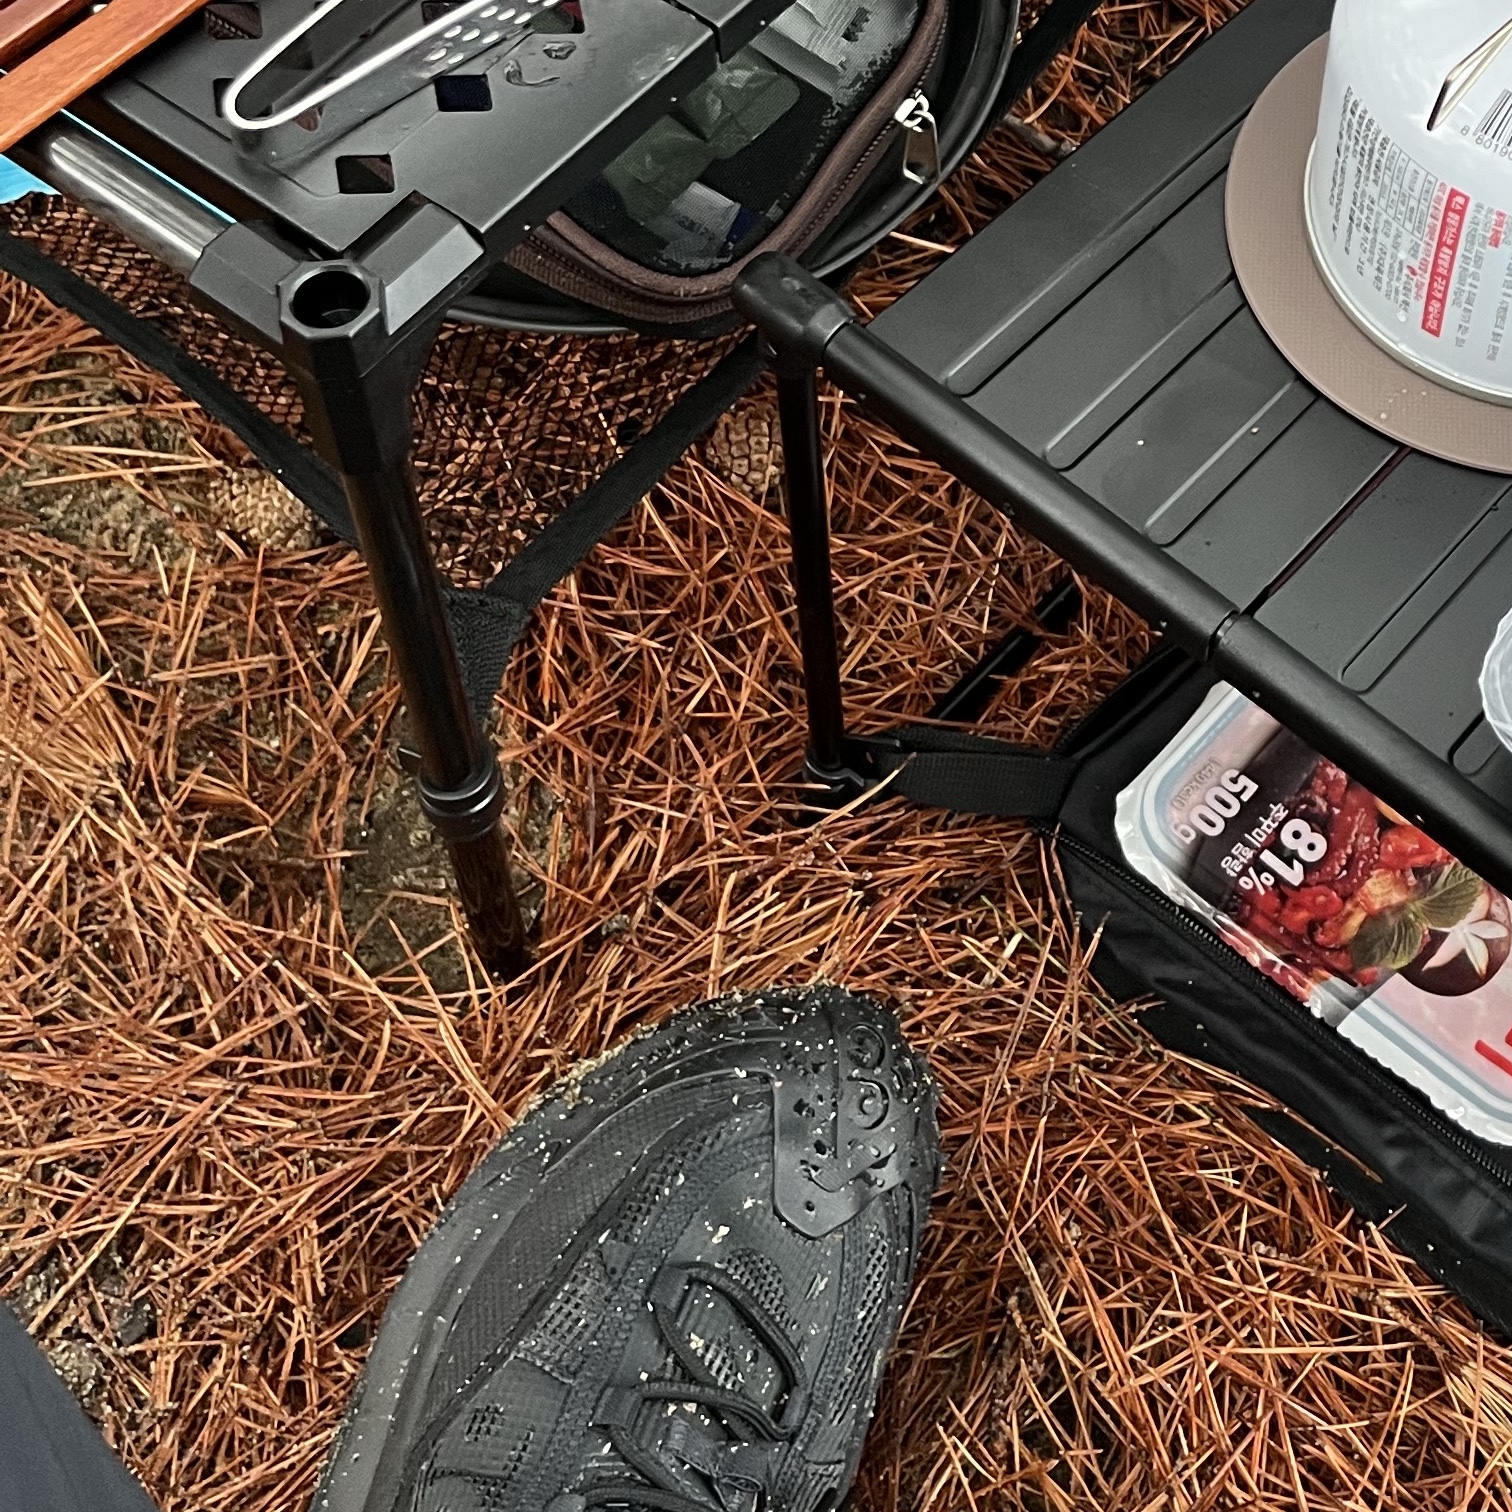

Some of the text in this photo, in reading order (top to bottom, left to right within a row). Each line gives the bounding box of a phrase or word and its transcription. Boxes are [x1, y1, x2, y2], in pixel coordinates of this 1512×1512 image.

[1190, 769, 1259, 837] 500
[1220, 842, 1255, 878] 함량
[1238, 818, 1328, 896] 81%
